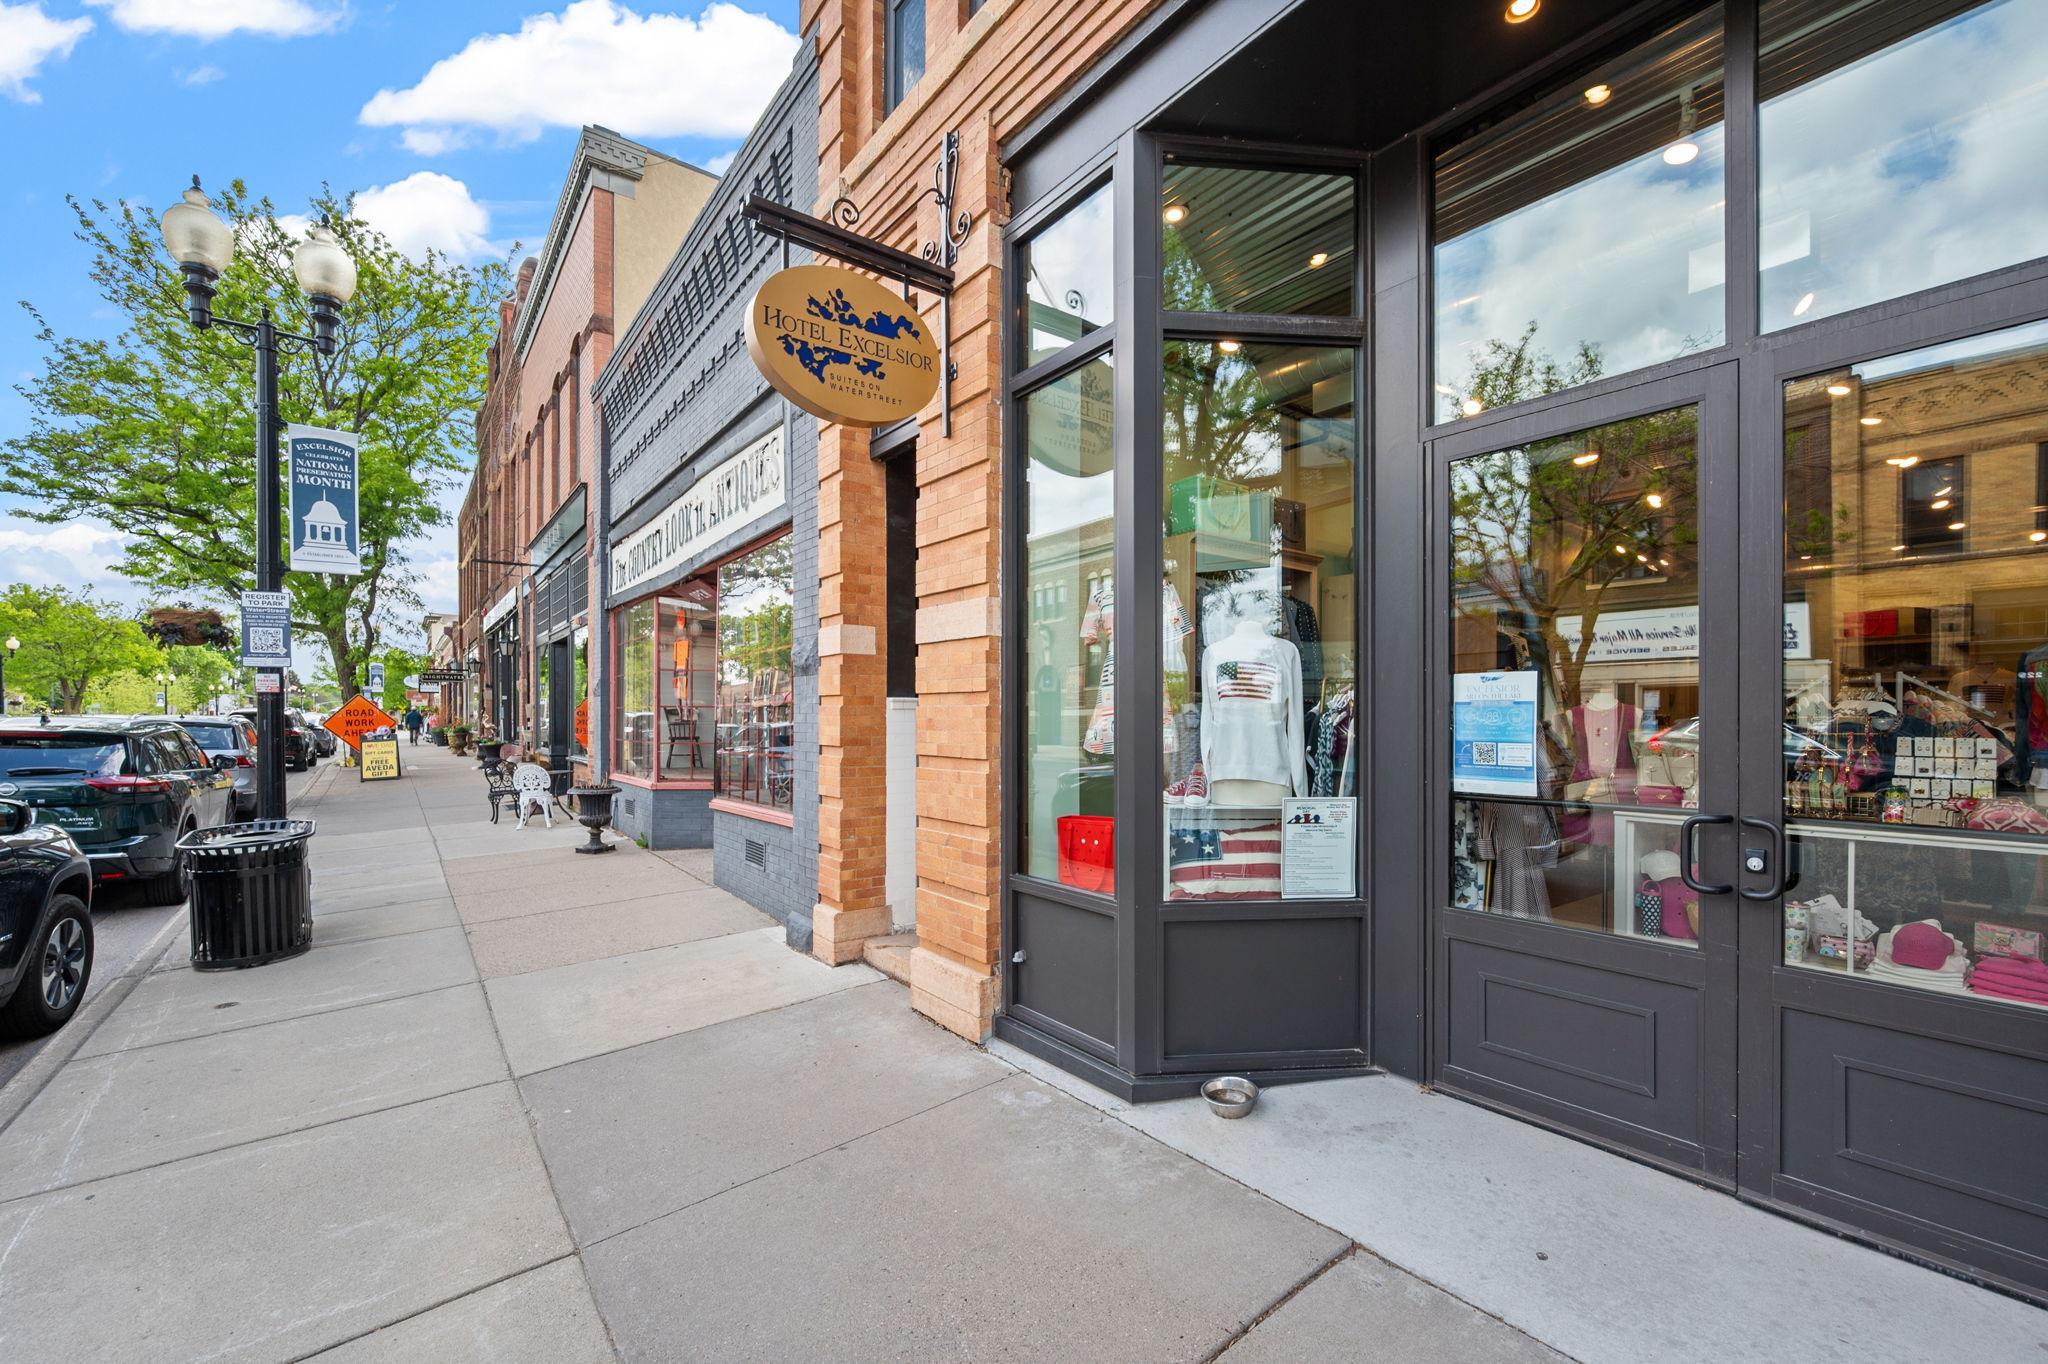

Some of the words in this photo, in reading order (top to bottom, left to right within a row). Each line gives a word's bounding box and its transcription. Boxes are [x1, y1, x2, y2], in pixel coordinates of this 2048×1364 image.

[839, 327, 933, 372] EXCELSIOR
[829, 372, 866, 389] SUITES
[868, 380, 882, 392] ON
[829, 382, 864, 398] WATER
[866, 391, 903, 406] STREET
[296, 442, 352, 458] EXCELSIOR
[296, 458, 352, 473] NATIONAL
[296, 466, 352, 479] PRESERVATION
[296, 474, 351, 490] MONTH
[628, 528, 664, 583] COUNTRY
[665, 501, 693, 558] LOOK
[709, 436, 781, 530] ANTIQUES
[245, 593, 286, 601] REGISTER
[345, 709, 375, 717] ROAD
[345, 719, 375, 727] WORK
[365, 764, 395, 772] AVEDA
